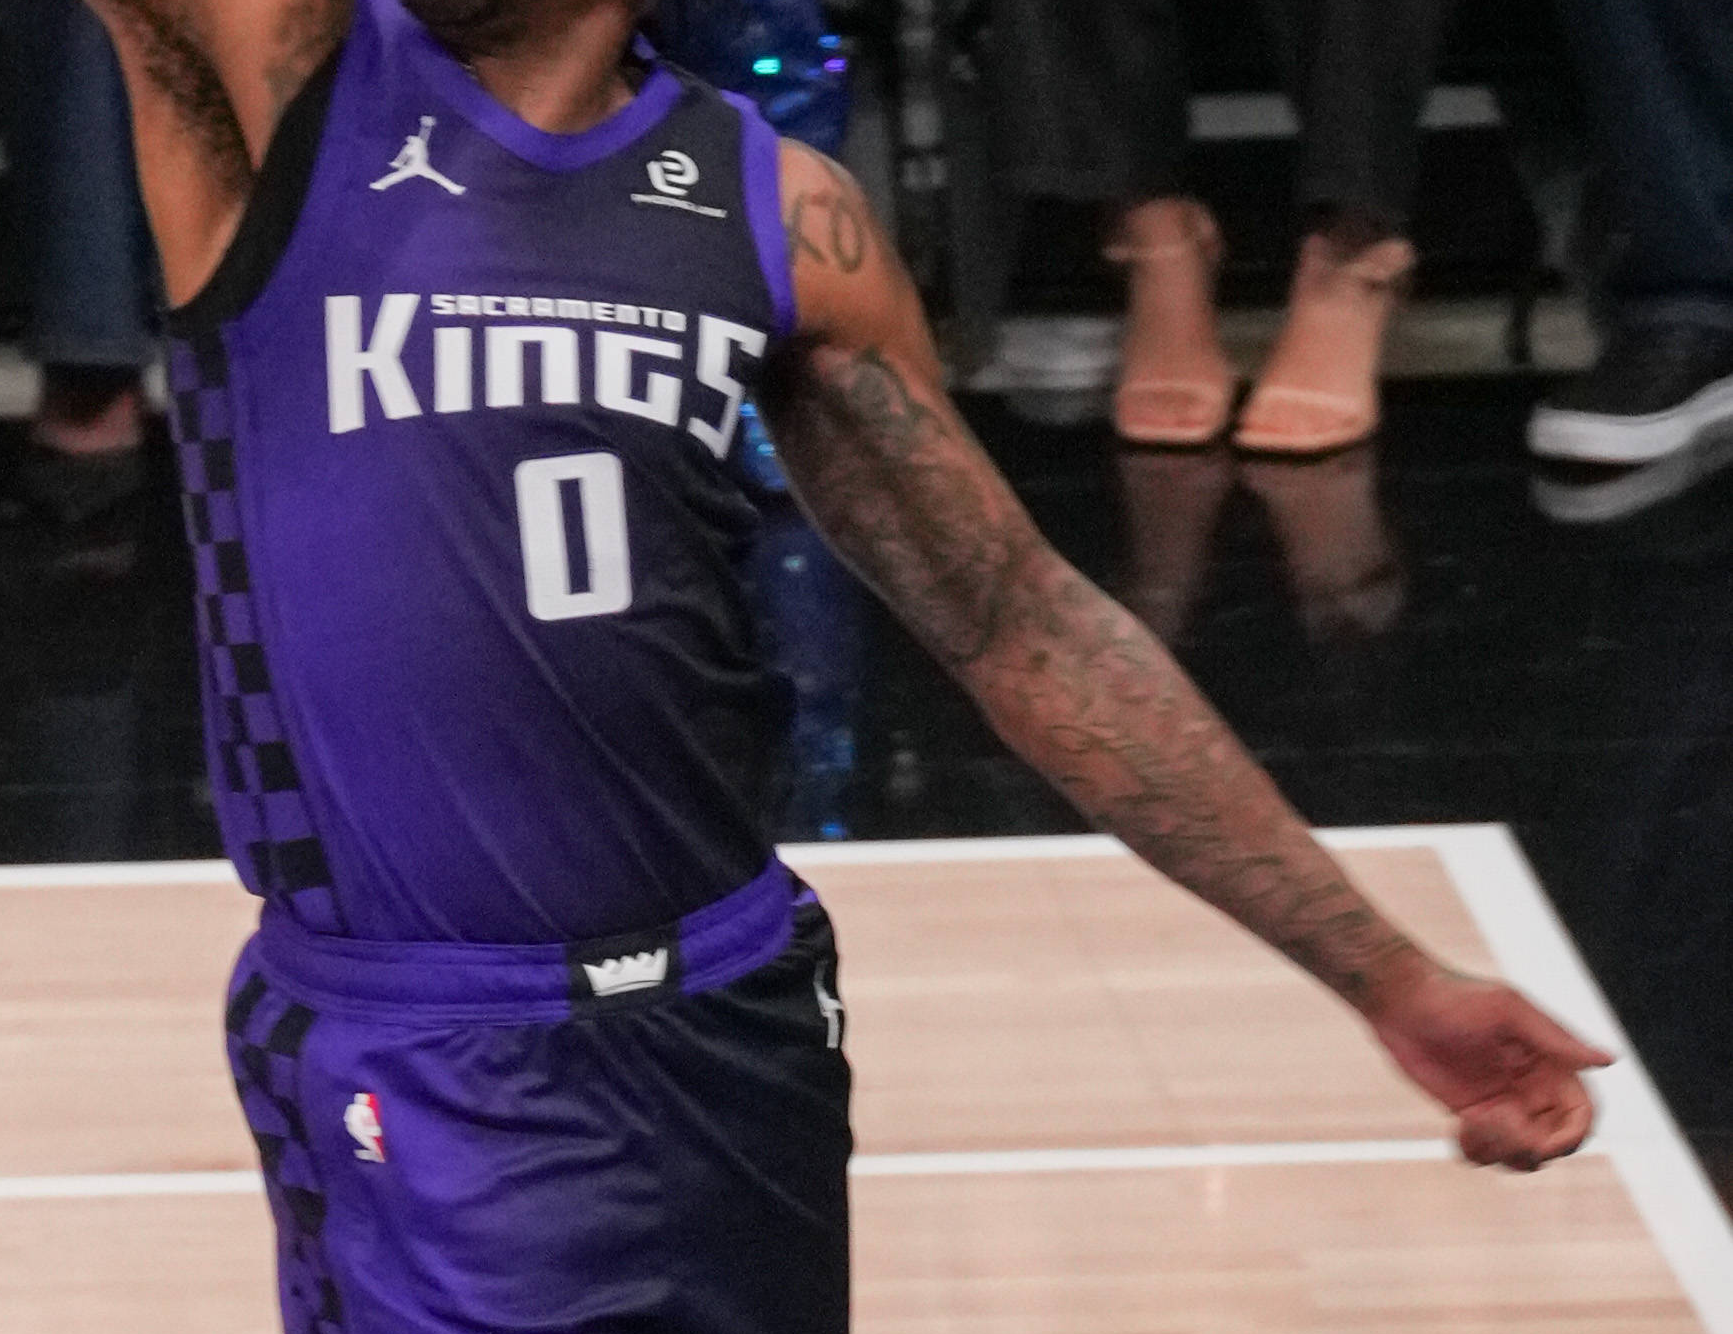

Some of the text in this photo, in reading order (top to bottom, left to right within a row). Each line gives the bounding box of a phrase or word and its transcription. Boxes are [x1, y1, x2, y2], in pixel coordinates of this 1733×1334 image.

[325, 292, 767, 459] KINGS
[429, 293, 688, 332] SACRAMENTO
[513, 452, 633, 622] 0
